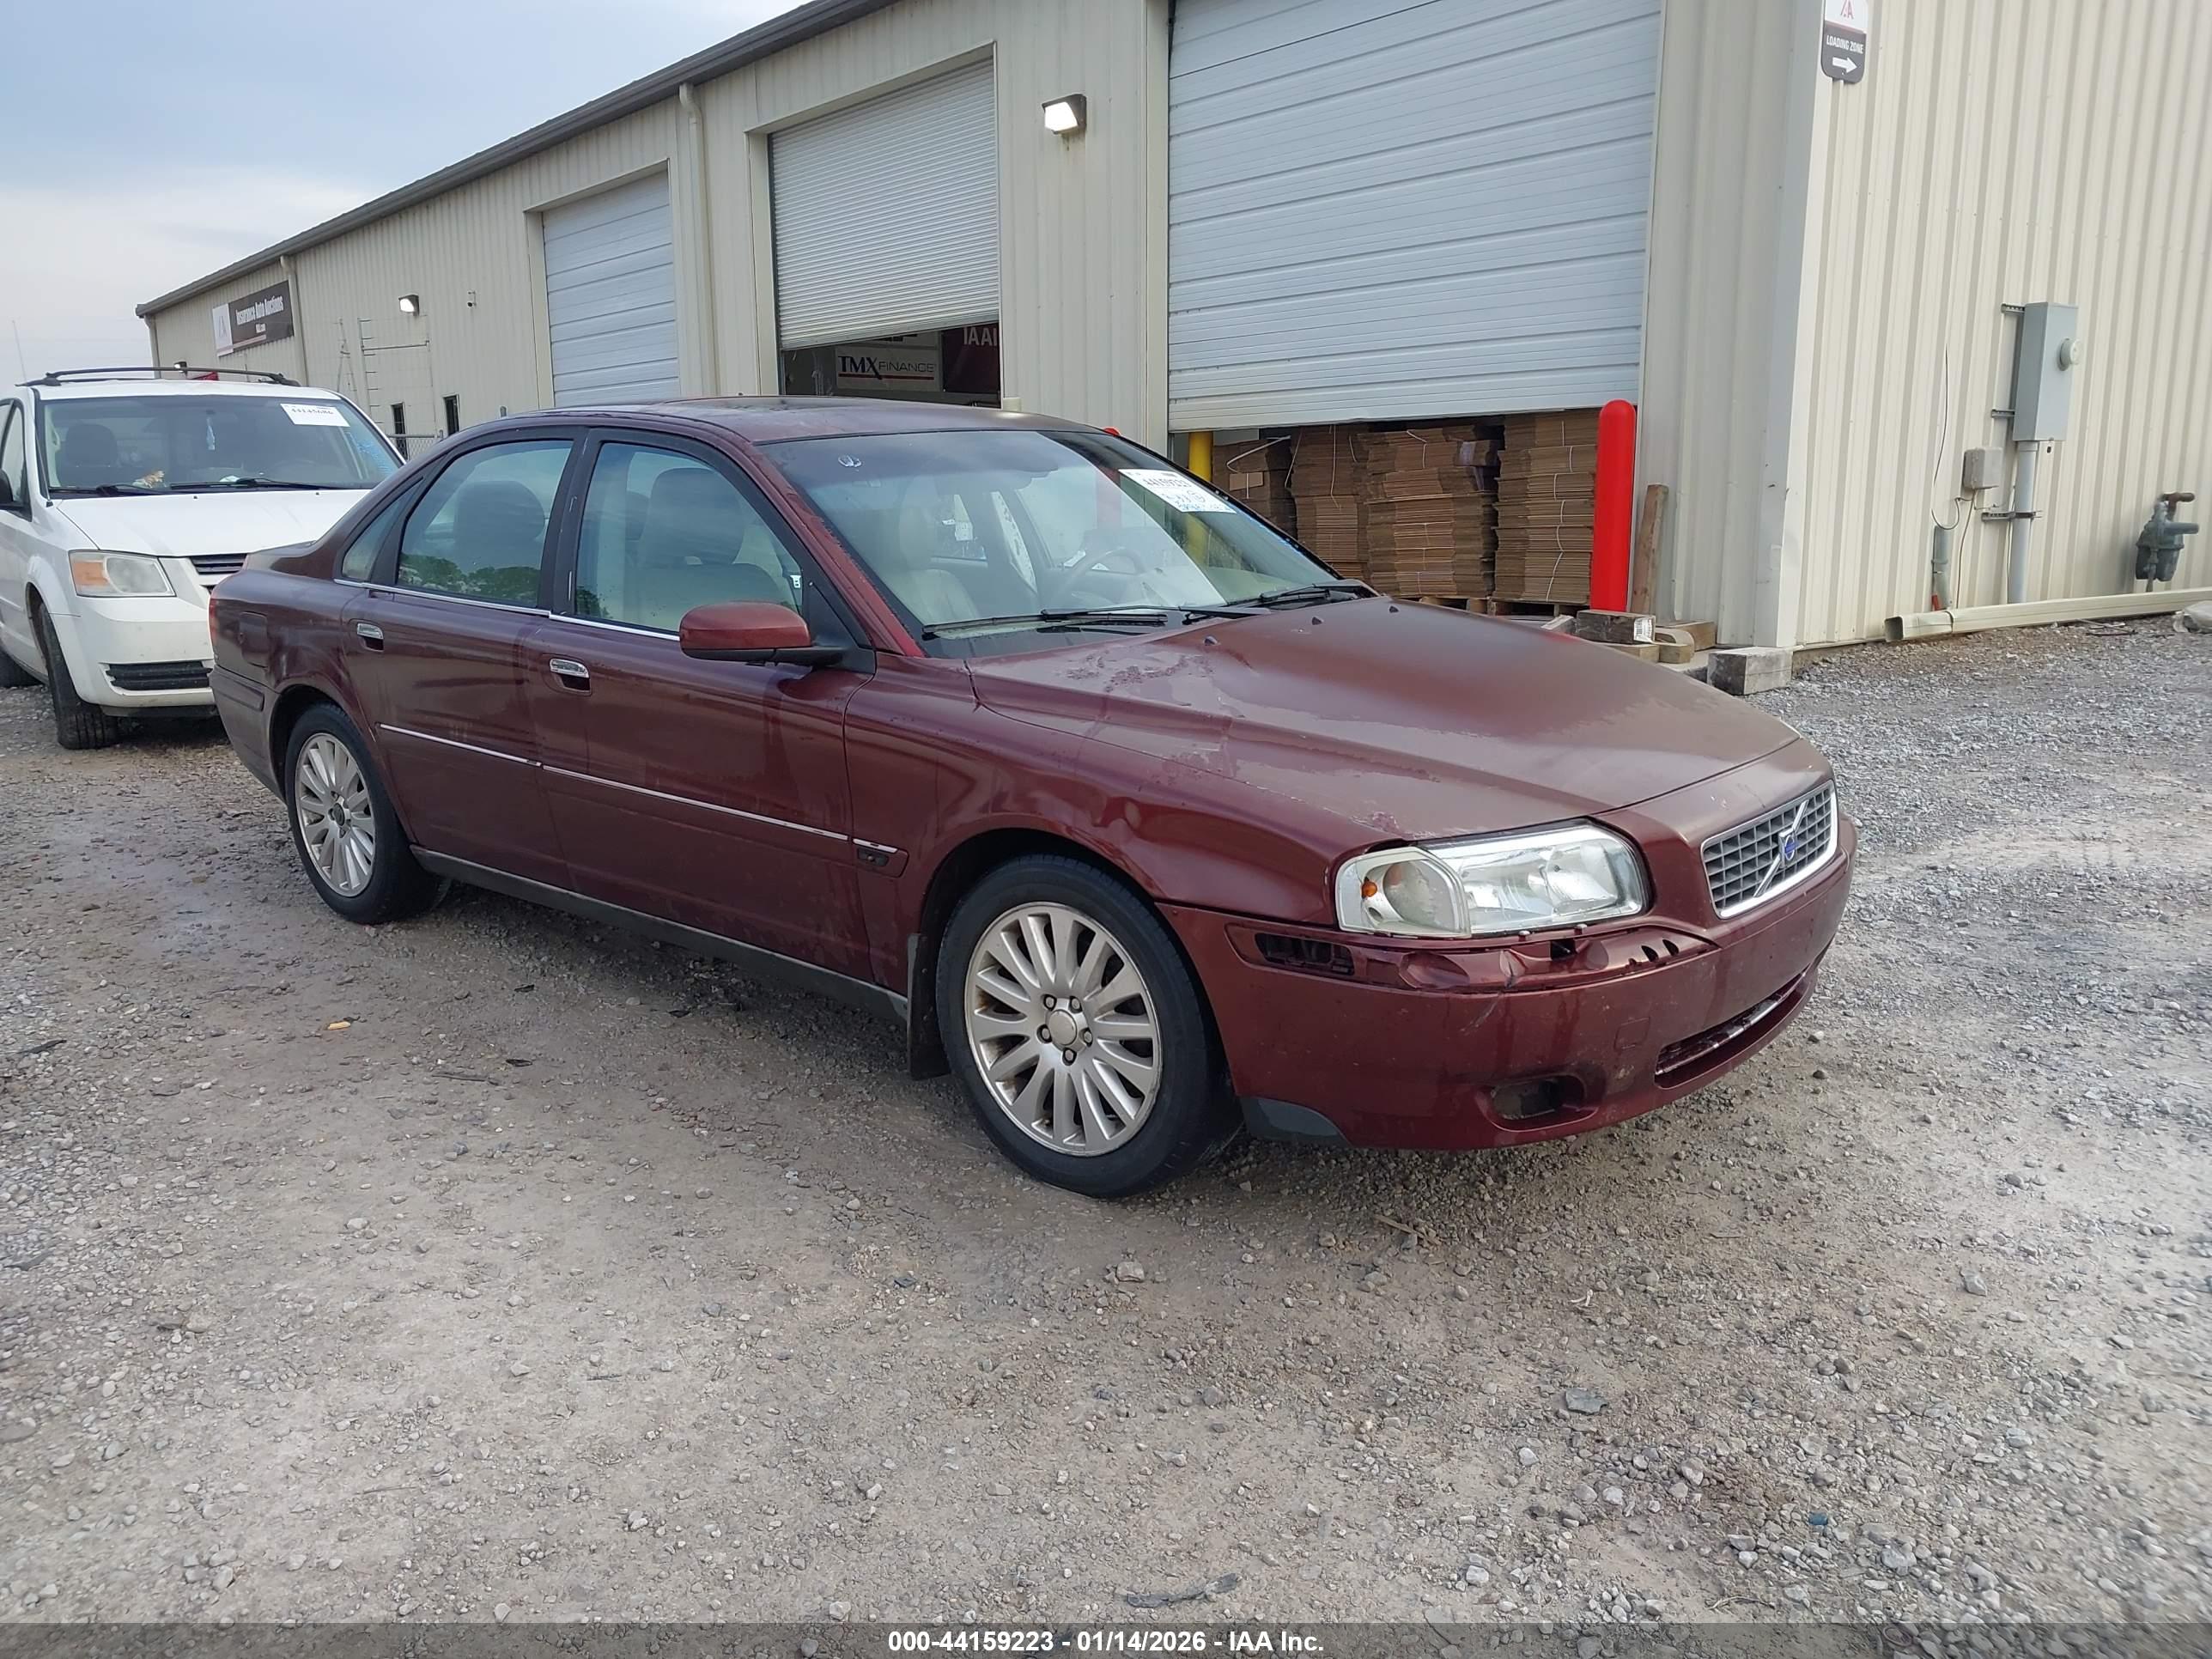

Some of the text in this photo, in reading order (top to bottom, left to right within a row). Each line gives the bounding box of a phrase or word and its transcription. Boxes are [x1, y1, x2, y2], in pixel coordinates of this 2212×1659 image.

[1826, 35, 1864, 54] LOADING ZONE
[838, 356, 933, 380] TMX FINANCE
